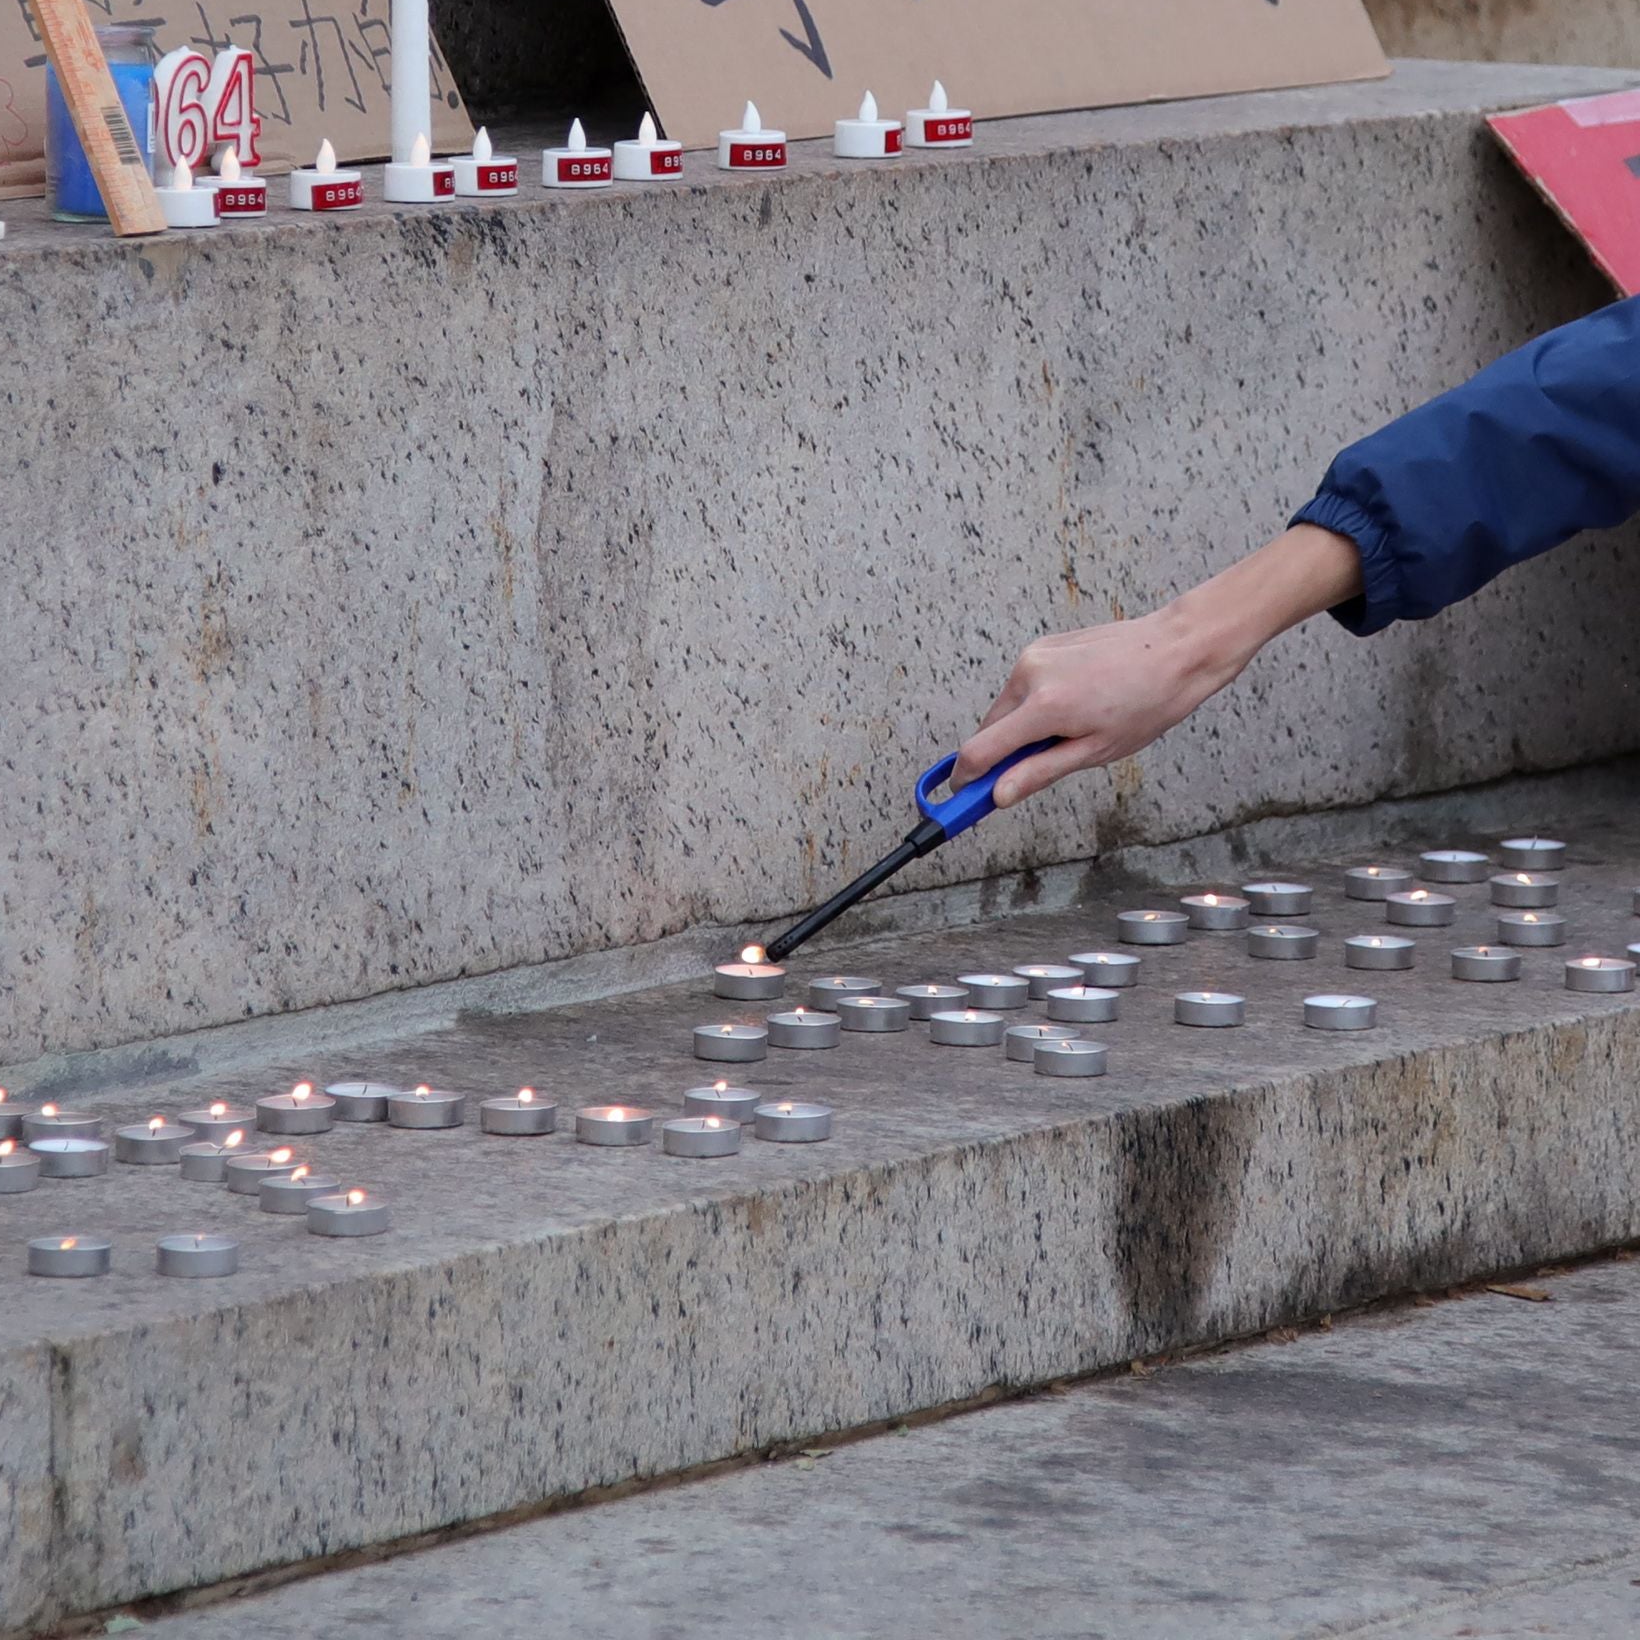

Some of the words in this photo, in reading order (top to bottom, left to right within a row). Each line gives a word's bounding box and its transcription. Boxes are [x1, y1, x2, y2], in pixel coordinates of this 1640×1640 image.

[163, 52, 262, 171] 64
[743, 148, 783, 161] 8964
[571, 163, 610, 175] 8964
